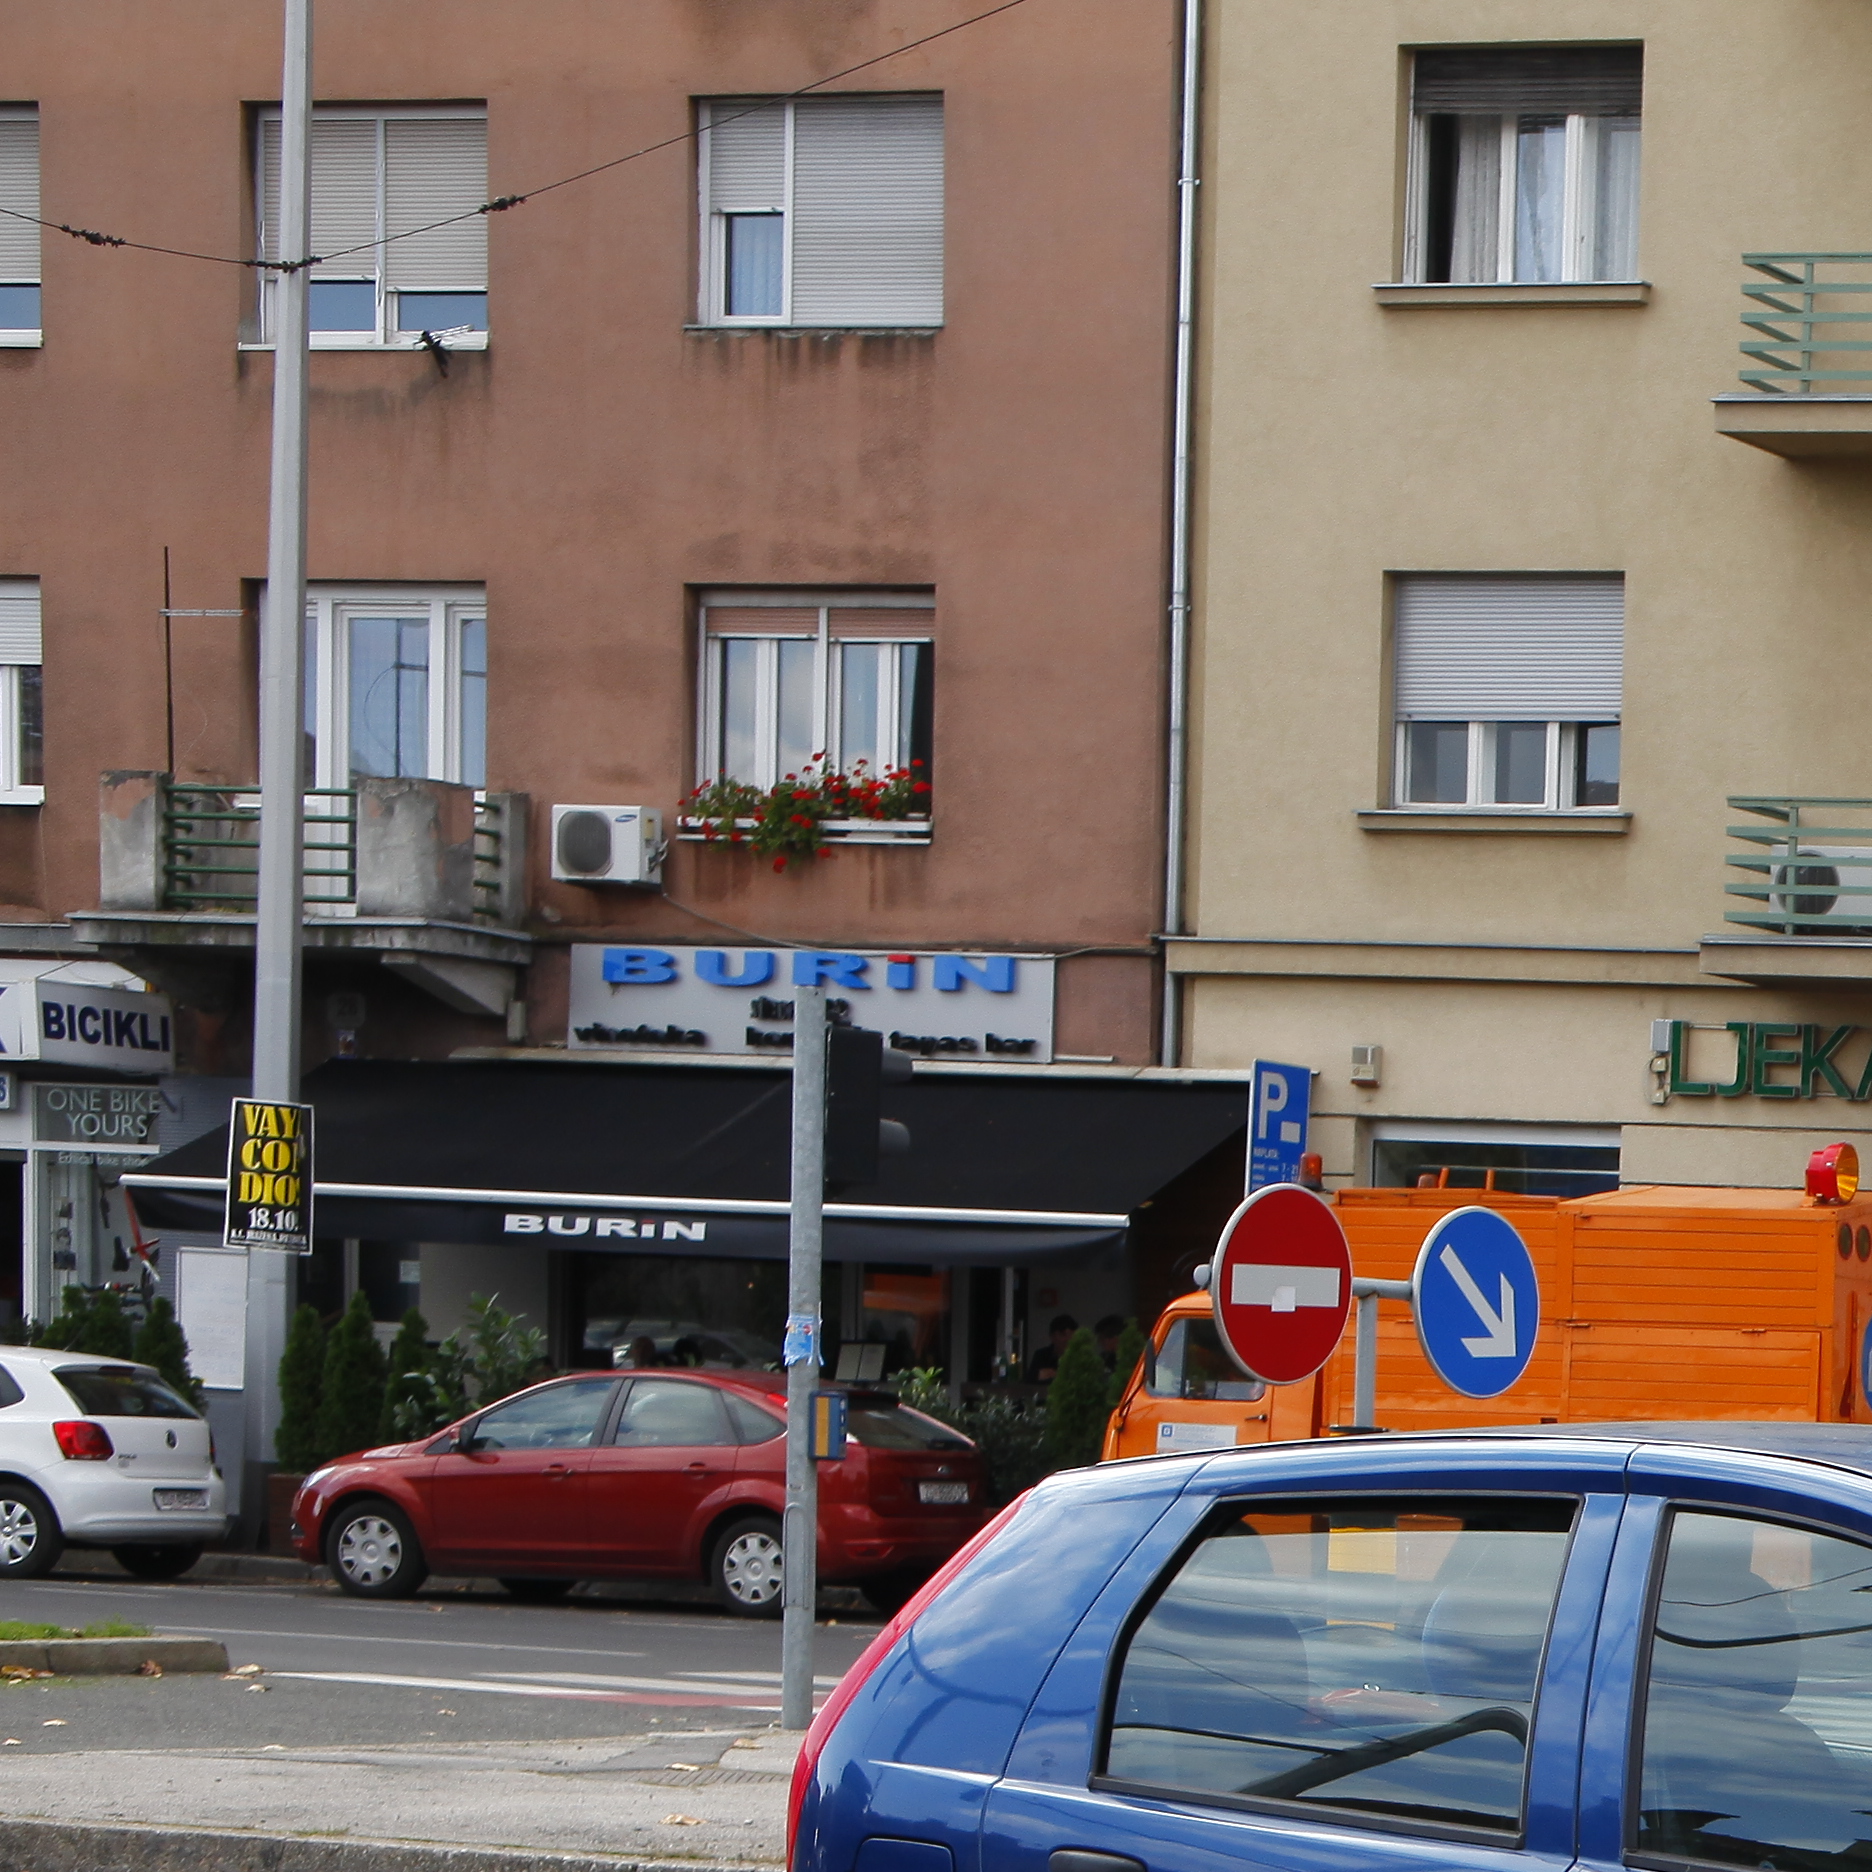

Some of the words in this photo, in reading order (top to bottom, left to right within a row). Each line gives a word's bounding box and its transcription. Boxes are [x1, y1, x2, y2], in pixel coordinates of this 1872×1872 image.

[42, 1000, 171, 1052] BICIKLI
[47, 1088, 102, 1111] ONE
[110, 1089, 161, 1114] BIKE
[1258, 1070, 1289, 1140] P
[66, 1112, 149, 1138] YOURS
[242, 1104, 301, 1138] VAY
